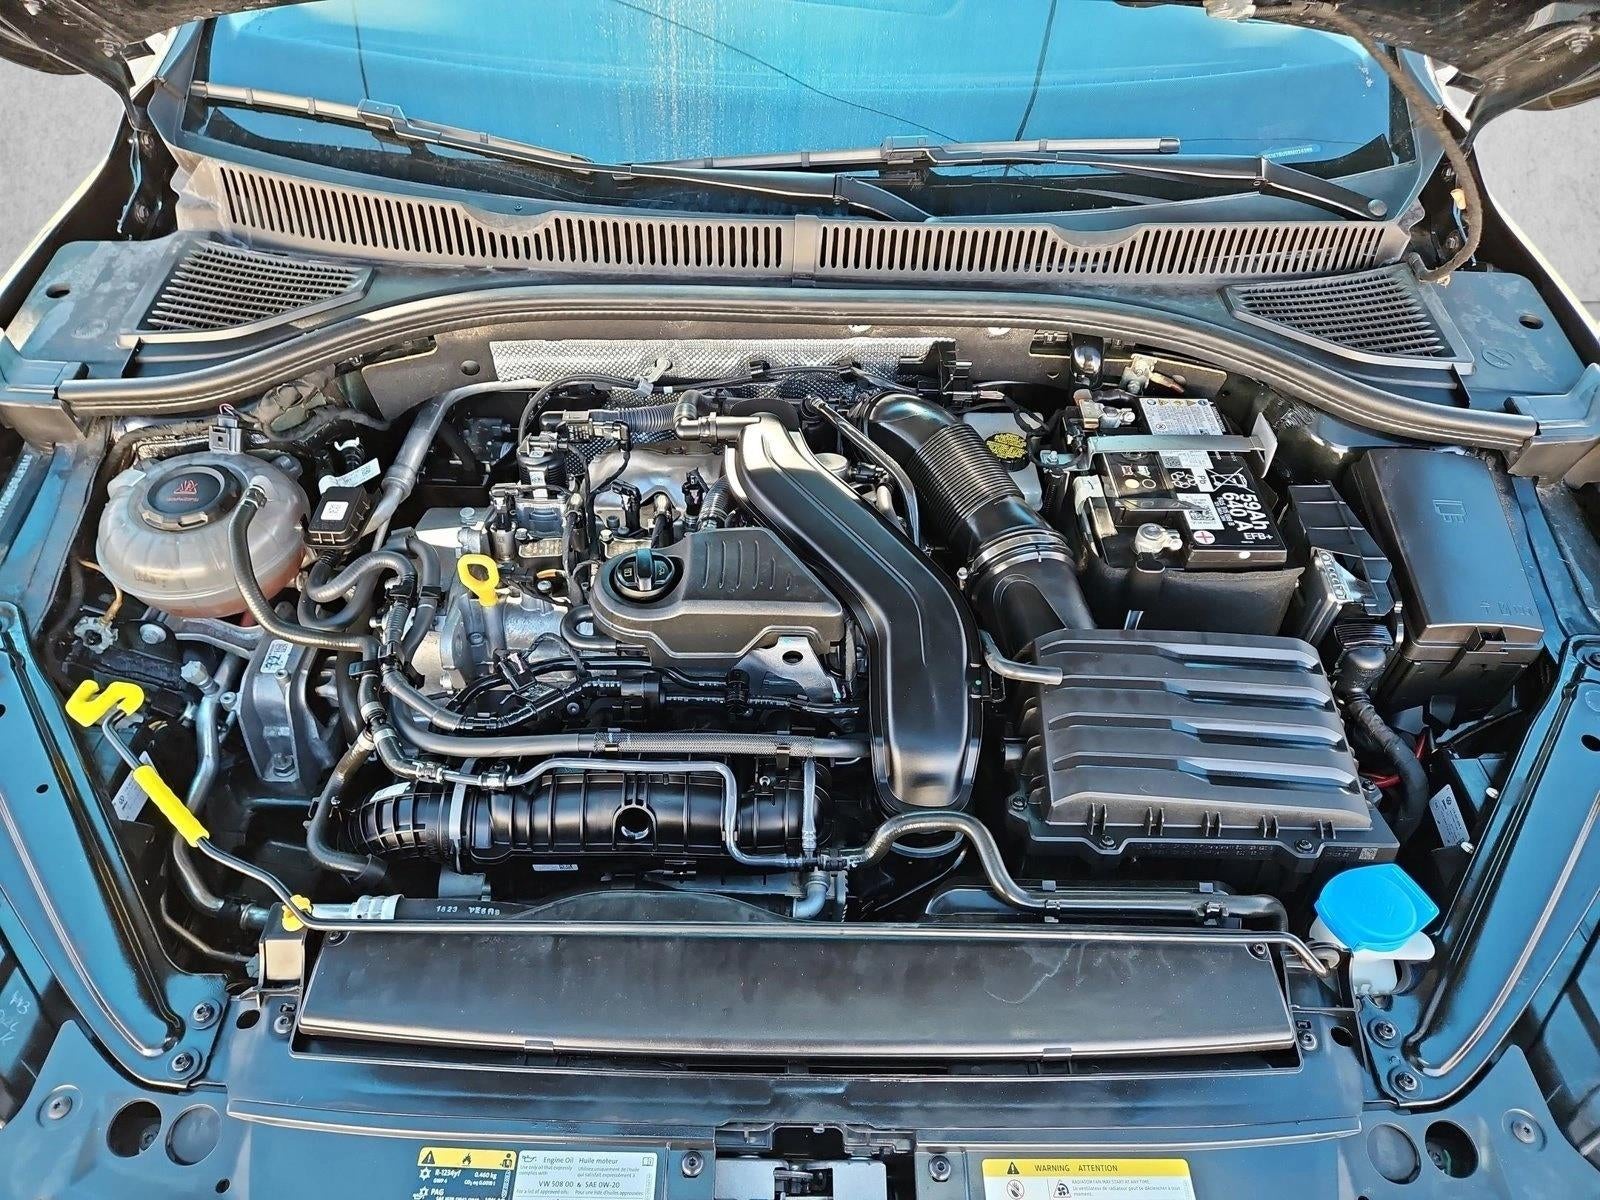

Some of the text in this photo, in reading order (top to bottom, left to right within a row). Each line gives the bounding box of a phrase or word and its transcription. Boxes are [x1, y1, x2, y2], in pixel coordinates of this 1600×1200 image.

[1222, 492, 1248, 517] 640
[1240, 493, 1270, 530] 59Ah
[1233, 520, 1254, 531] A
[1243, 532, 1273, 540] EFB+
[436, 905, 458, 913] 1823
[543, 1156, 564, 1165] Engine
[565, 1156, 574, 1164] Oil
[1034, 1164, 1070, 1172] WARNING
[1078, 1164, 1118, 1172] ATTENTION
[551, 1180, 564, 1188] 508
[564, 1180, 574, 1188] 00
